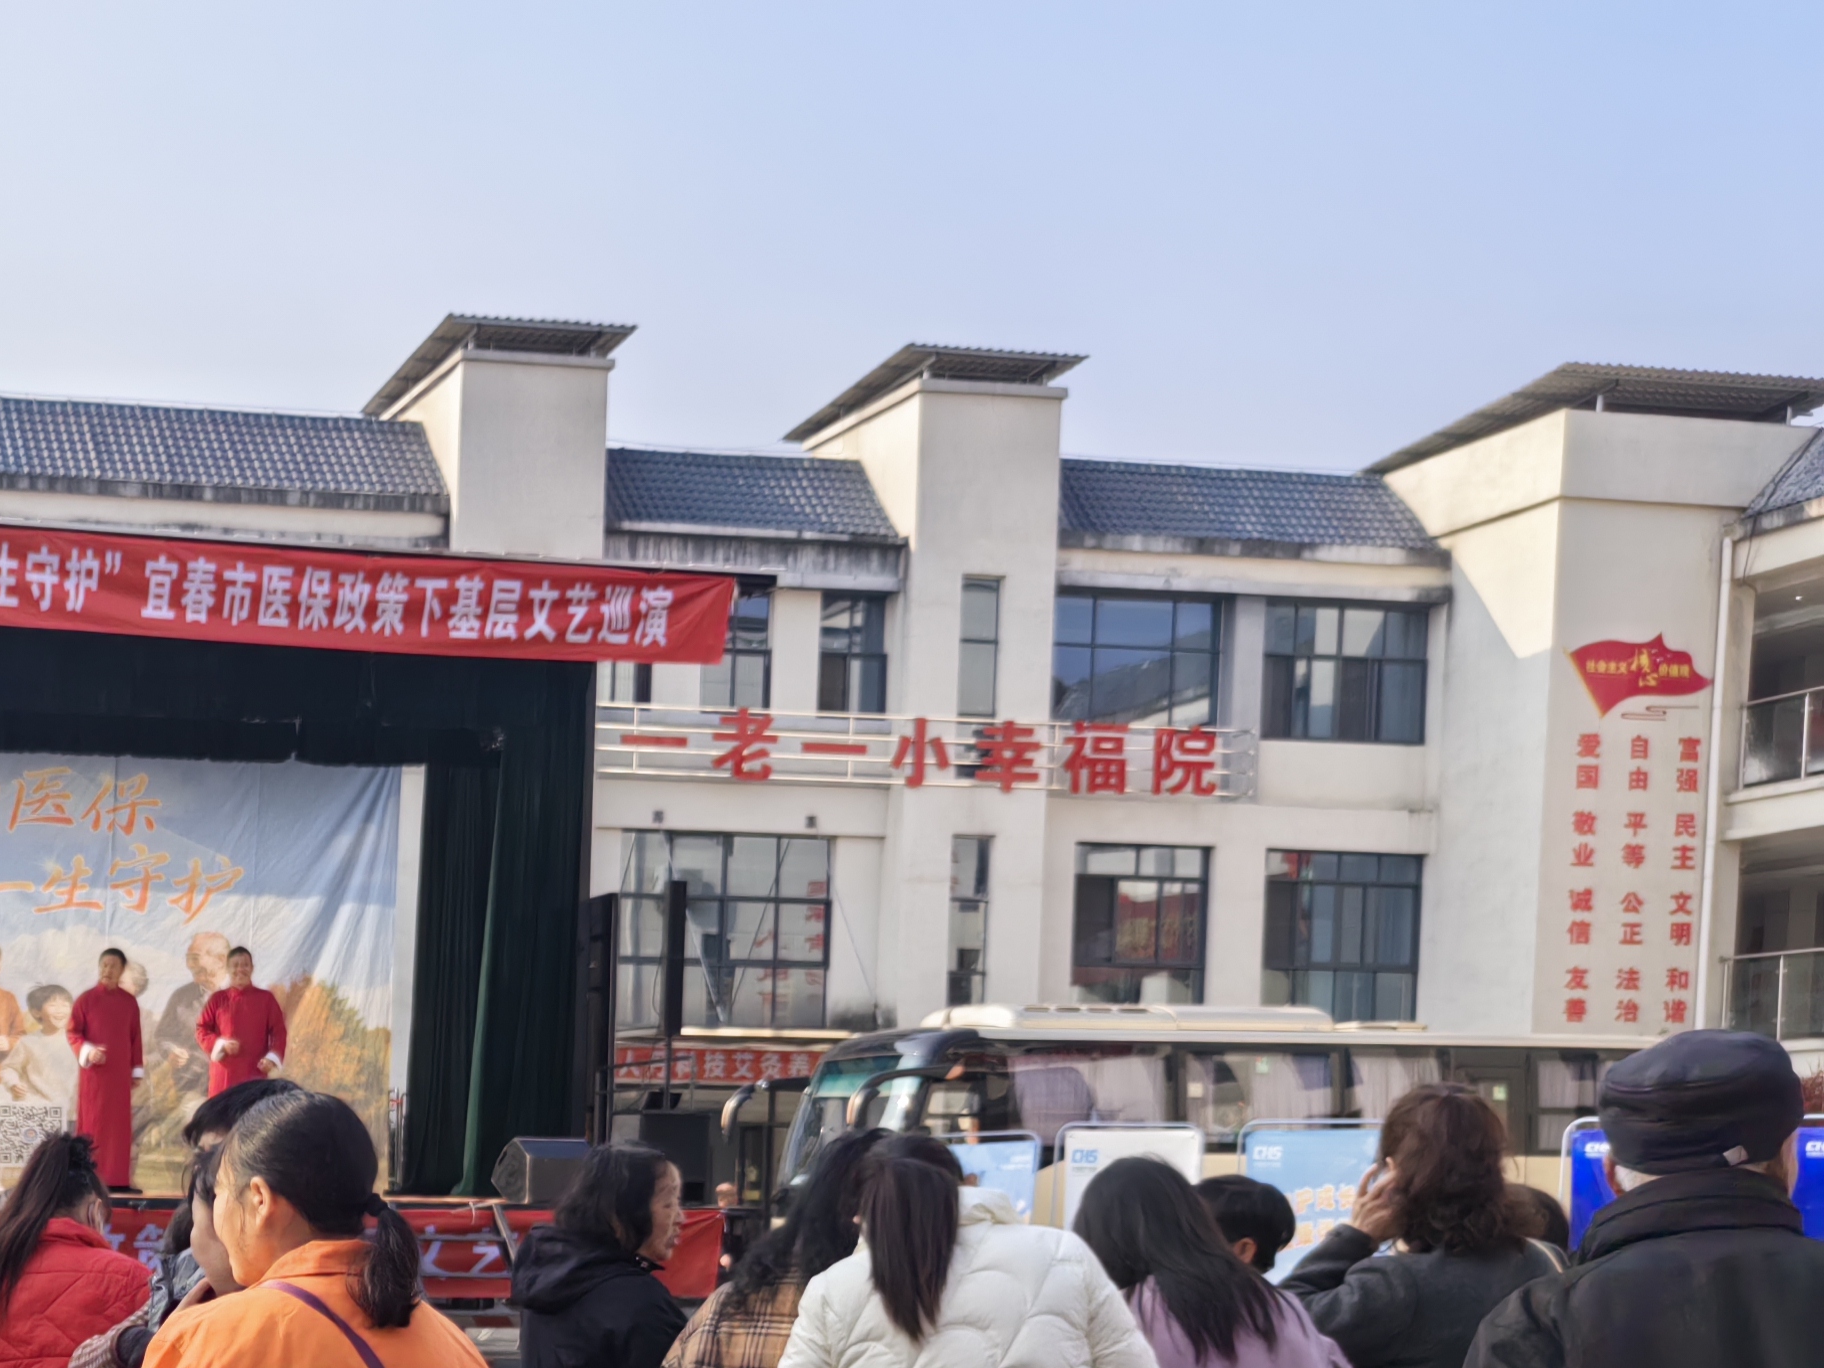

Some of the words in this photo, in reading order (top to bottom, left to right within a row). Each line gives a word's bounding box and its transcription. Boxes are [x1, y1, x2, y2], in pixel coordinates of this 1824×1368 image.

[620, 706, 1218, 797] 一老一小幸福院
[1575, 734, 1599, 789] 爱国
[1629, 736, 1647, 790] 自由
[1677, 738, 1700, 793] 富强
[1572, 813, 1595, 868] 敬业
[1623, 813, 1645, 868] 平等
[1672, 815, 1695, 869] 民主
[1568, 889, 1591, 945] 诚信
[1619, 893, 1642, 946] 公正
[1670, 893, 1691, 946] 文明
[1564, 967, 1588, 1023] 友善
[1616, 968, 1639, 1023] 法治
[1665, 968, 1688, 1023] 和谐
